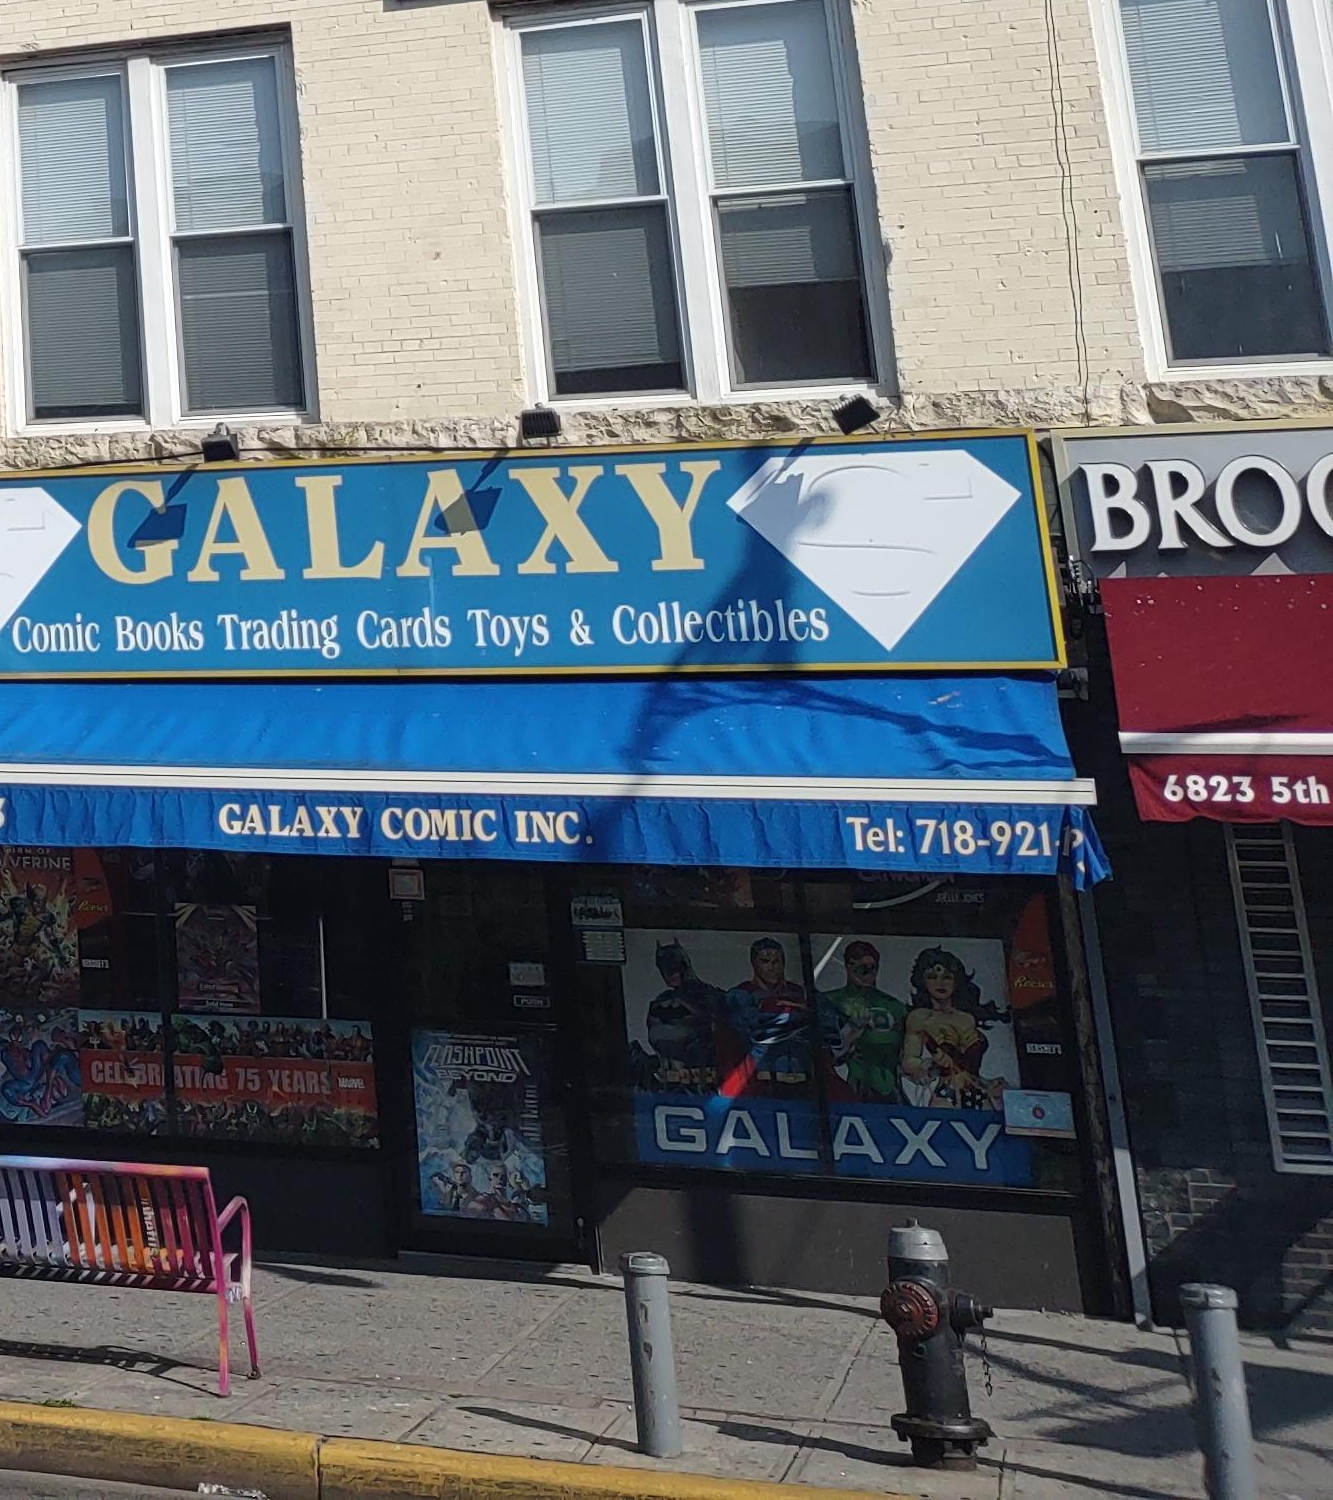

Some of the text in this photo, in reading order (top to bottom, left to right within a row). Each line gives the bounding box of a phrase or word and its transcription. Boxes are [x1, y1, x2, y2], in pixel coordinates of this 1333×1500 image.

[87, 459, 721, 585] GALAXY
[12, 599, 830, 659] Comic Books Trading Cards Toys & Collectibles
[1163, 774, 1330, 805] 6823 5th
[218, 804, 363, 840] GALAXY
[380, 808, 498, 843] COMIC
[514, 810, 594, 846] INC.
[845, 817, 906, 855] Tel:
[90, 1059, 333, 1096] CELEBRATING 75 YEARS
[436, 1069, 518, 1083] BEYOND
[652, 1104, 1002, 1171] GALAXY
